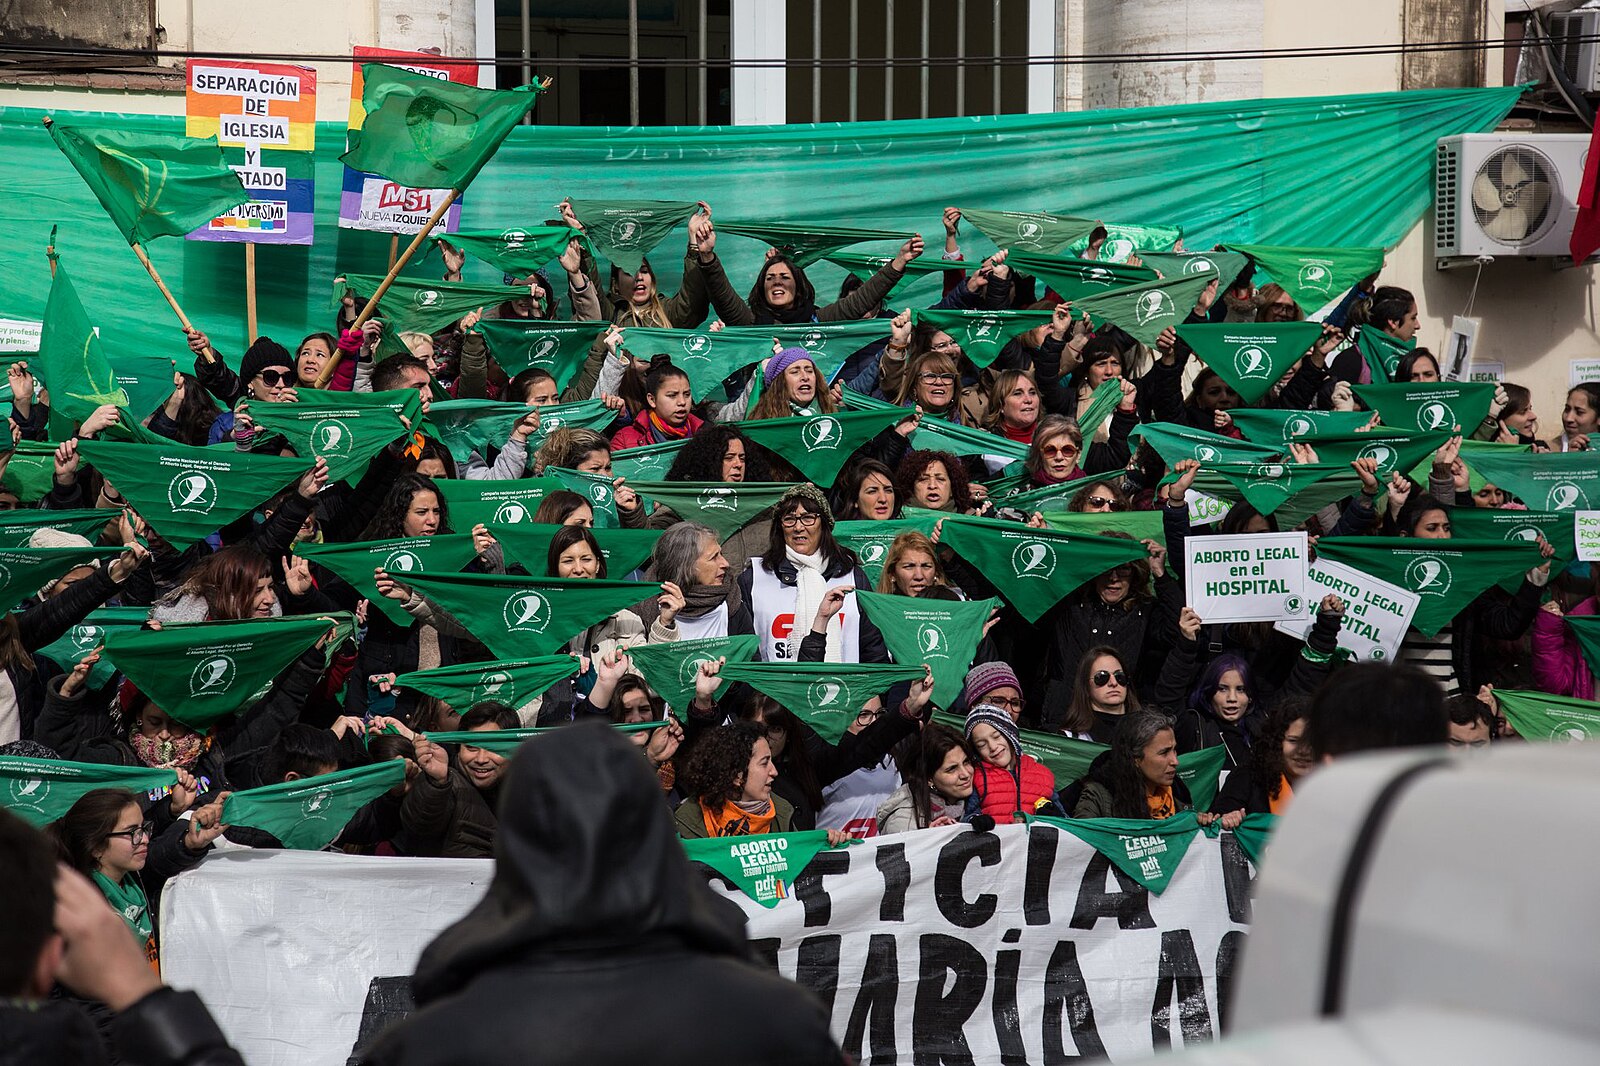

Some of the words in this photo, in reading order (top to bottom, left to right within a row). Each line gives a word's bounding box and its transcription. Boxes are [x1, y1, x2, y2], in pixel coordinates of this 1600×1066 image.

[196, 74, 297, 97] SEPARACIÓN
[245, 98, 266, 114] DE
[224, 122, 285, 139] IGLESIA
[246, 150, 256, 165] Y
[236, 171, 284, 187] STADO
[382, 185, 431, 210] MST
[238, 202, 284, 219] DIVERSIDAD
[360, 210, 391, 222] NUEVA
[1470, 373, 1500, 382] LEGAL
[1194, 549, 1250, 564] ABORTO
[1256, 547, 1299, 560] LEGAL
[1230, 566, 1247, 576] en
[1252, 562, 1265, 576] el
[1206, 579, 1290, 597] HOSPITAL
[1308, 568, 1360, 598] ABORTO
[1364, 591, 1404, 617] LEGAL
[1353, 604, 1368, 616] el
[730, 838, 788, 857] ABORTO
[1125, 835, 1165, 851] LEGAL
[740, 851, 787, 868] LEGAL
[1140, 856, 1161, 876] pdt
[743, 866, 761, 877] SEGURO
[761, 865, 767, 874] Y
[766, 862, 788, 874] GRATUITO
[755, 874, 777, 897] pdt
